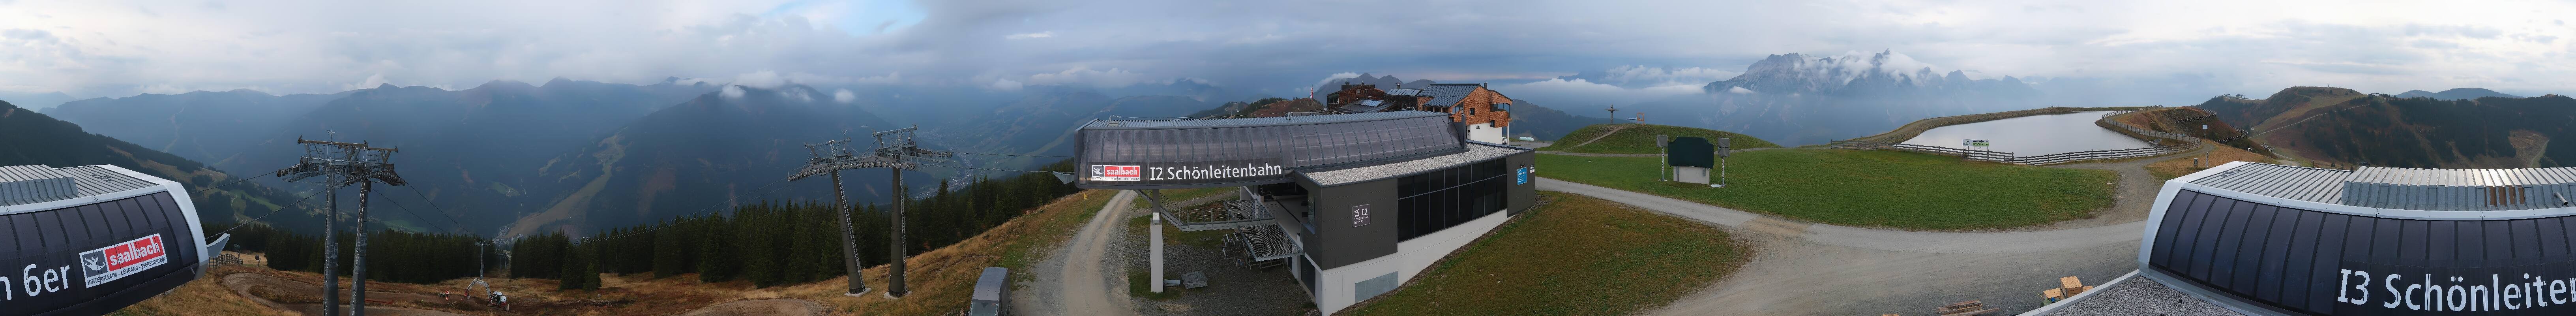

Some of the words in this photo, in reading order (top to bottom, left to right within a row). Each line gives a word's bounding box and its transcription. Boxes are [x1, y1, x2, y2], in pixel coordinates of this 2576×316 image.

[1107, 166, 1137, 175] saalbach
[1150, 167, 1163, 180] I2
[1167, 163, 1281, 180] Schönleitenbahn
[110, 237, 160, 266] saalbach
[23, 264, 70, 297] 6er
[87, 272, 117, 285] HINTERGLEMM
[121, 265, 139, 276] LEOGANG
[141, 257, 166, 269] FIEBERBRUNN
[2337, 269, 2370, 305] I3
